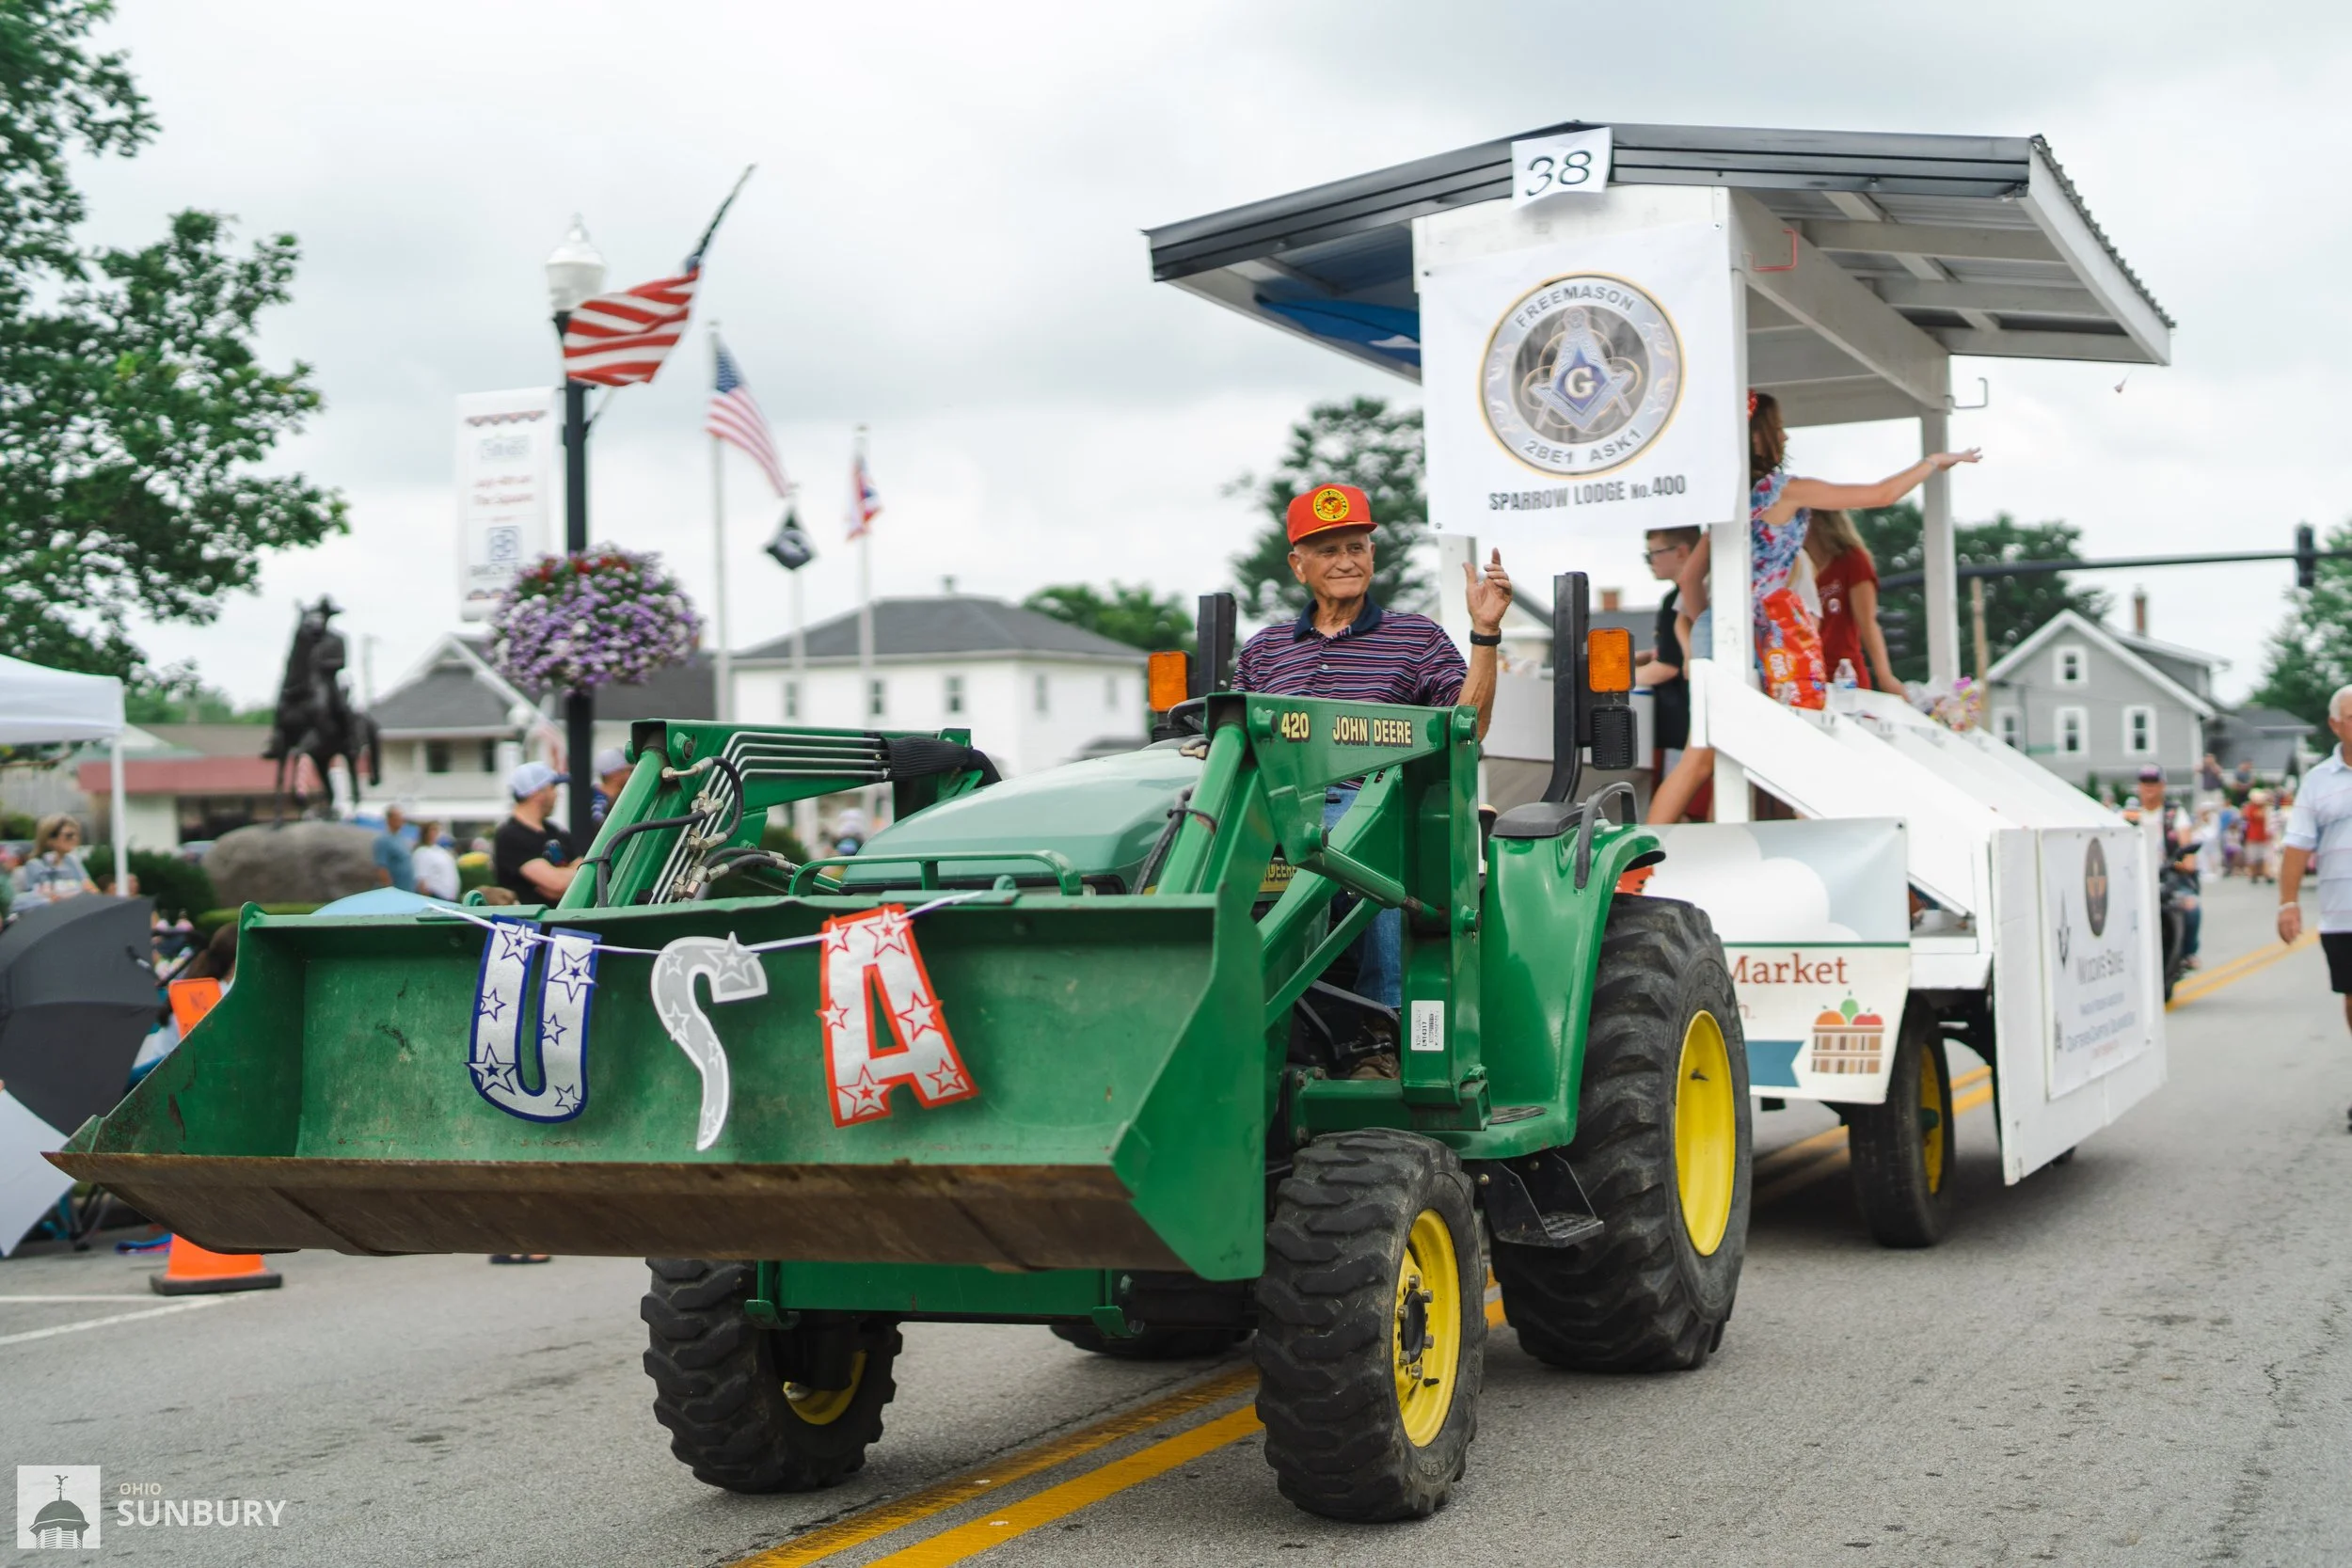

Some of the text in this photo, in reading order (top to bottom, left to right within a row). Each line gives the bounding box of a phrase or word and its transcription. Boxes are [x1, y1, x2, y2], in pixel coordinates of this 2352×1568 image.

[1525, 150, 1592, 197] 38
[1514, 285, 1635, 327] FREEMASON
[1564, 366, 1597, 399] G
[1523, 428, 1642, 465] 2BE1 ASK1
[1488, 486, 1568, 511] SPARROW
[1574, 480, 1626, 505] LODGE
[1280, 712, 1311, 741] 420
[1332, 715, 1413, 747] JOHN DEERE
